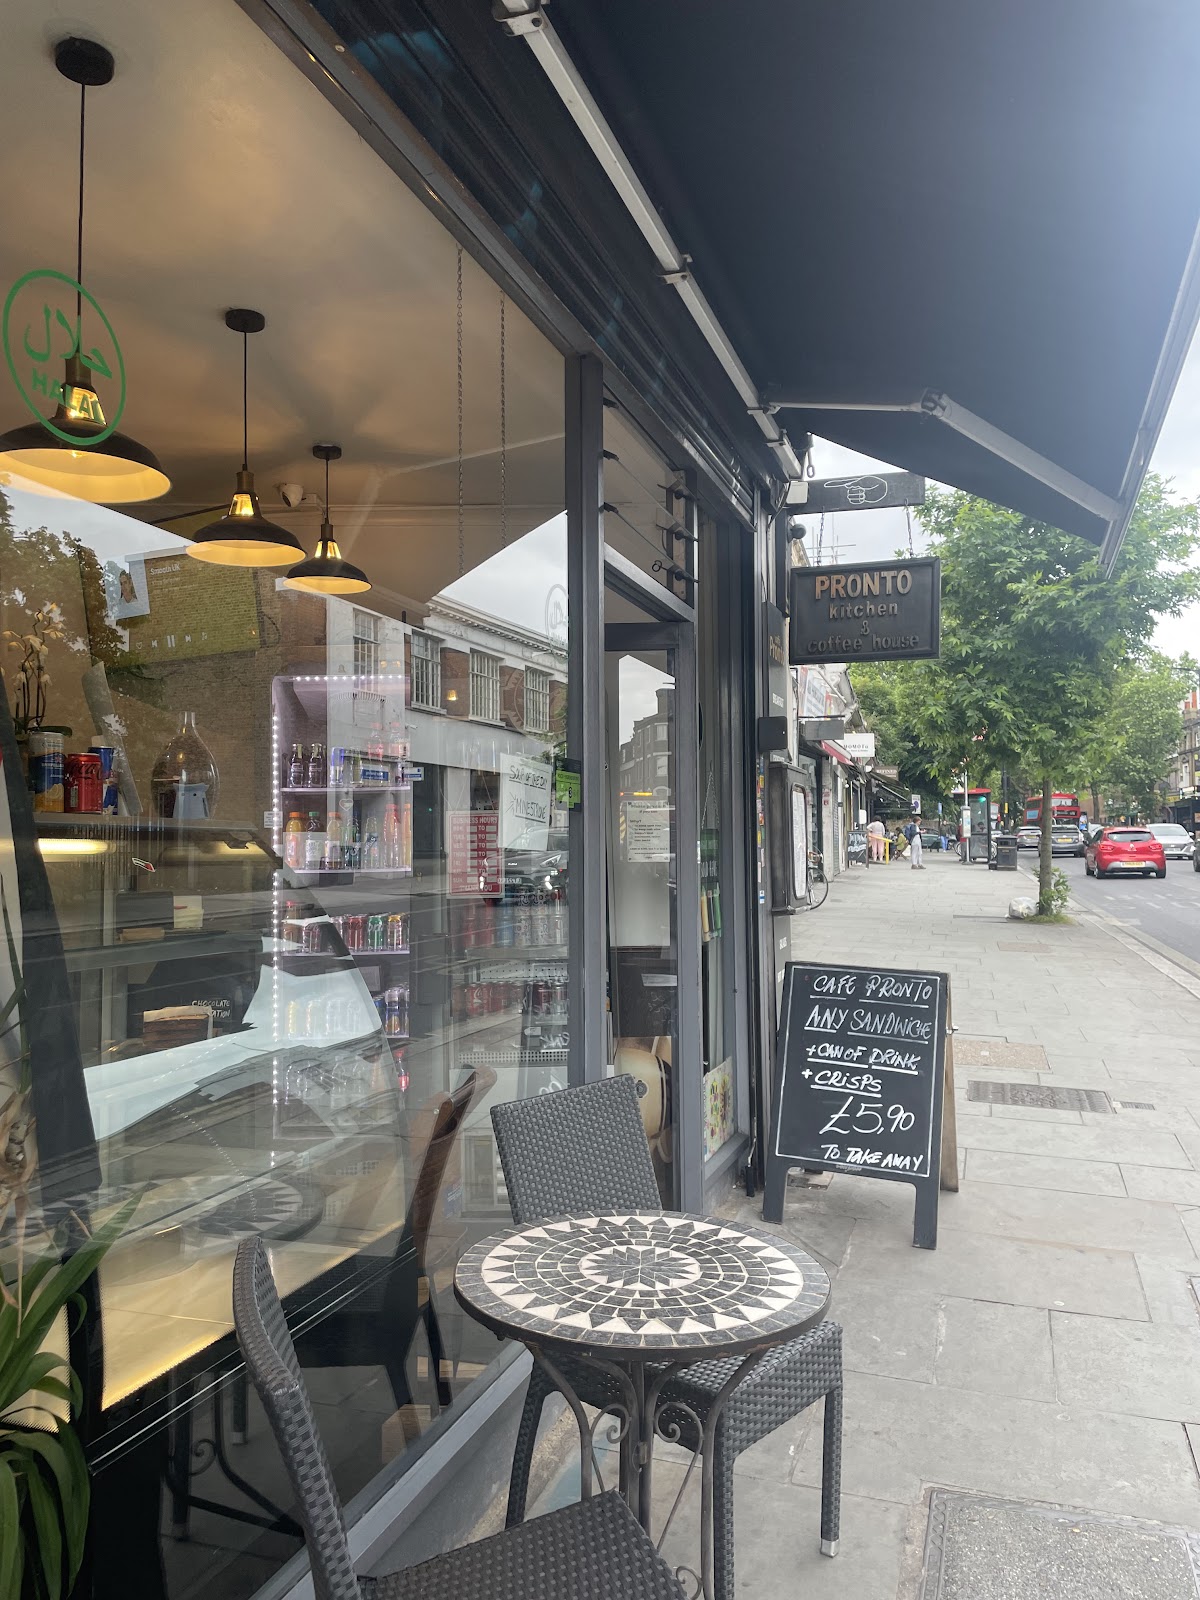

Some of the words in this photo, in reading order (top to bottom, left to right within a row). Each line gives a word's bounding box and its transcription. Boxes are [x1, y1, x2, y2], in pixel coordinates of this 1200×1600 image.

[815, 569, 913, 600] PRONTO
[829, 601, 898, 619] kitchen
[807, 634, 863, 653] coffee
[872, 634, 920, 650] house
[813, 975, 857, 995] CAFE
[865, 975, 933, 1002] PRONTO
[191, 999, 231, 1008] CHOCOLATE
[805, 1004, 849, 1029] ANY
[846, 1147, 883, 1165] TAKE
[880, 1153, 924, 1172] AWAY
